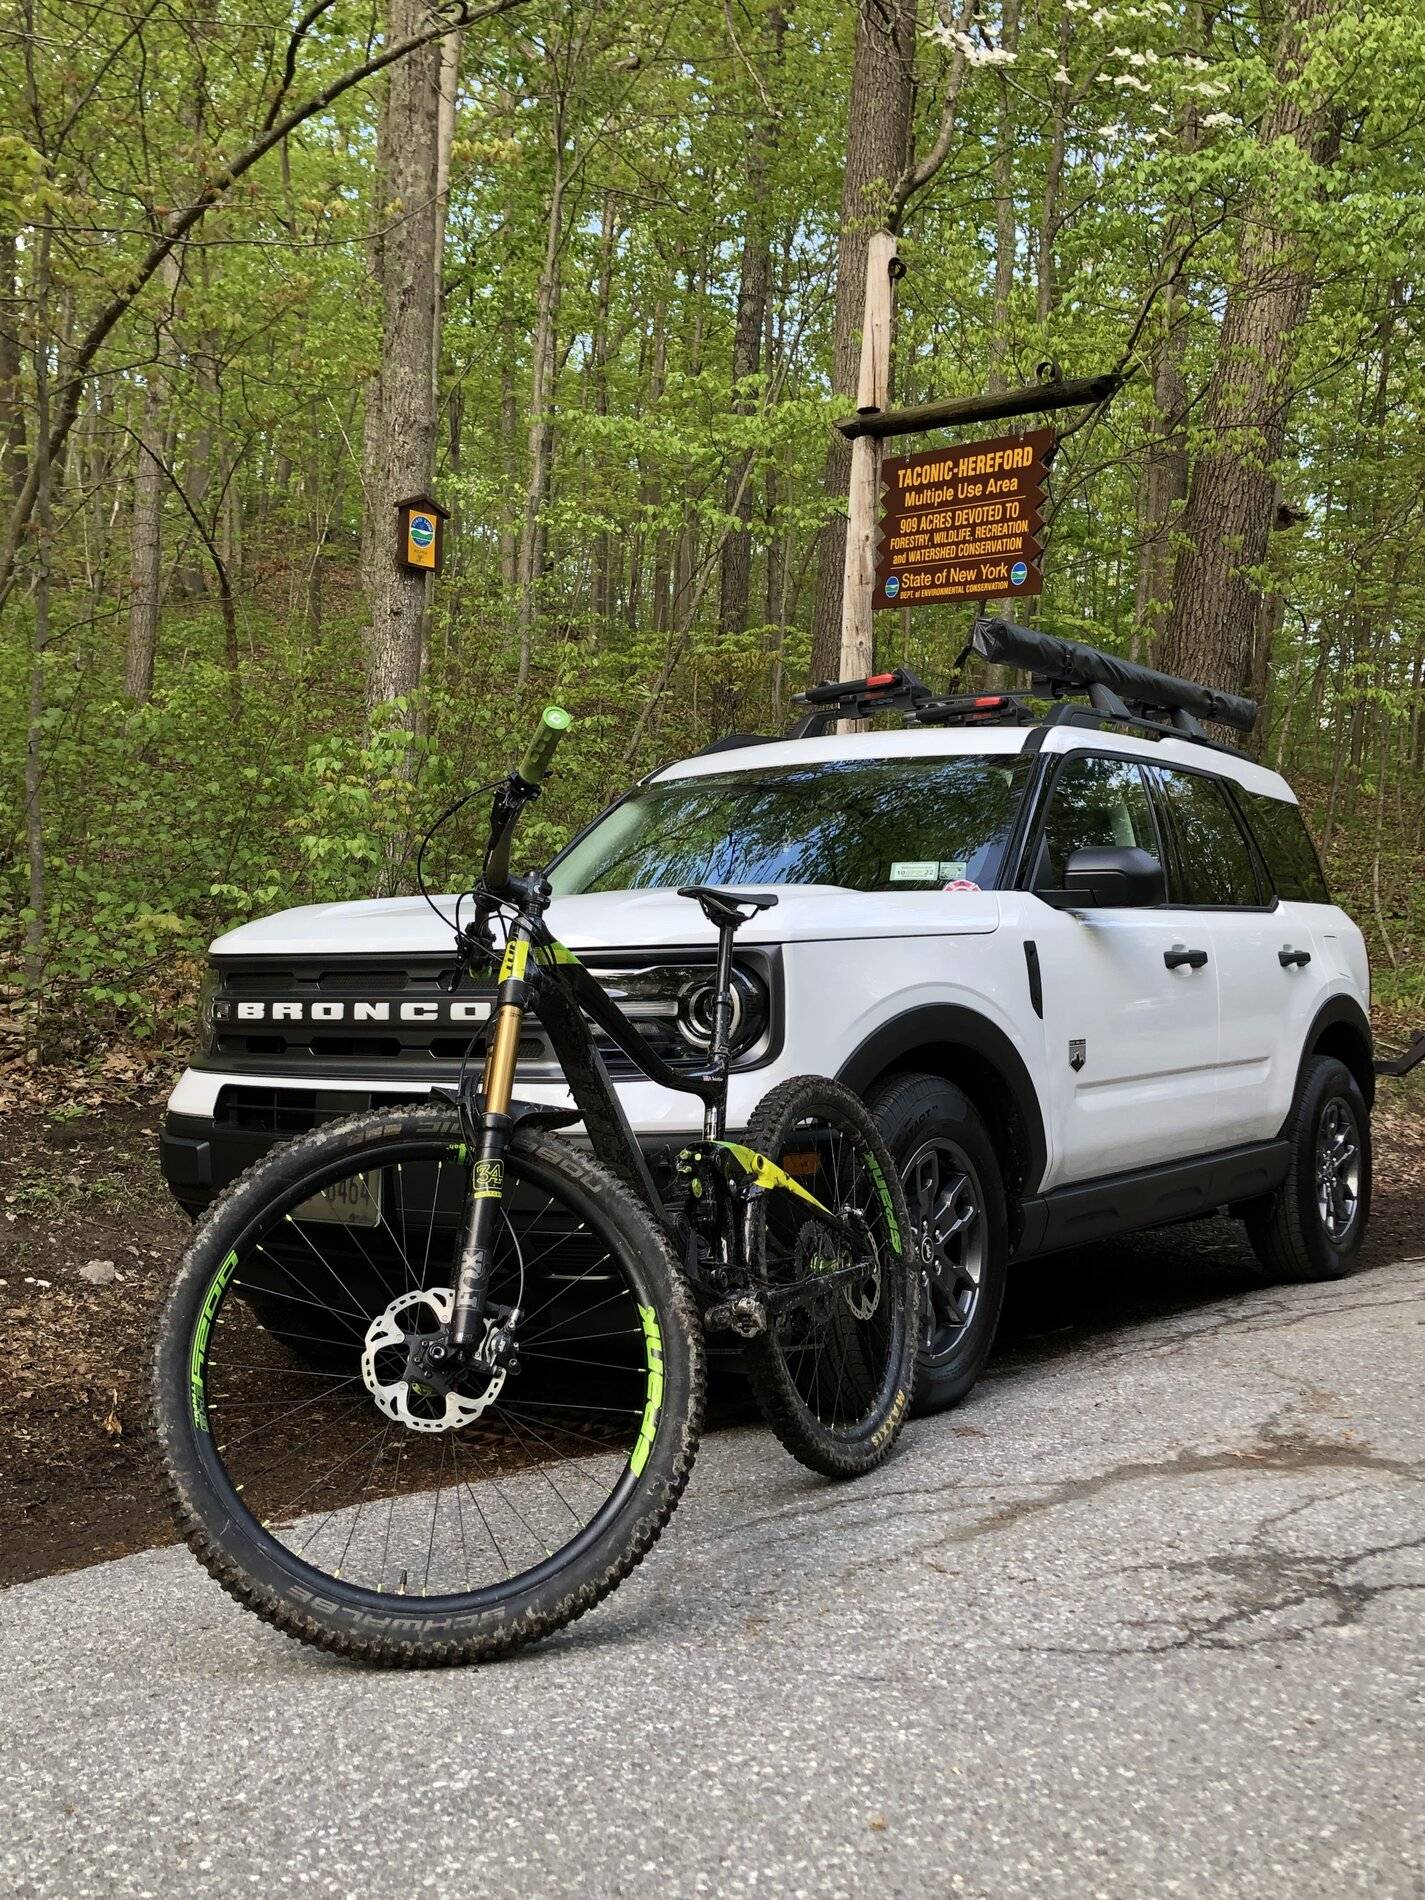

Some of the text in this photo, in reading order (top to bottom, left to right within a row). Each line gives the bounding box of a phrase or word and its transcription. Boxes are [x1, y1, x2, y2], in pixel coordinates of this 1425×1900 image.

[898, 447, 1033, 488] TACONIC-HEREFORD
[905, 478, 1018, 507] Multiple Use Area
[900, 502, 1019, 534] 909 ACRES DEVOTED TO
[890, 534, 931, 550] FORESTRY,
[933, 527, 973, 545] WILDLIFE,
[892, 537, 1022, 565] and WATERSHED CONSERVATION
[901, 563, 1008, 588] State of New York
[921, 586, 964, 598] ENVIRONMENTAL
[966, 581, 1008, 593] CONSERVATION
[237, 1002, 491, 1020] BRONCO
[476, 1164, 503, 1184] 34
[872, 1389, 906, 1447] MAXXIS
[286, 1584, 506, 1631] SCHWALBE
